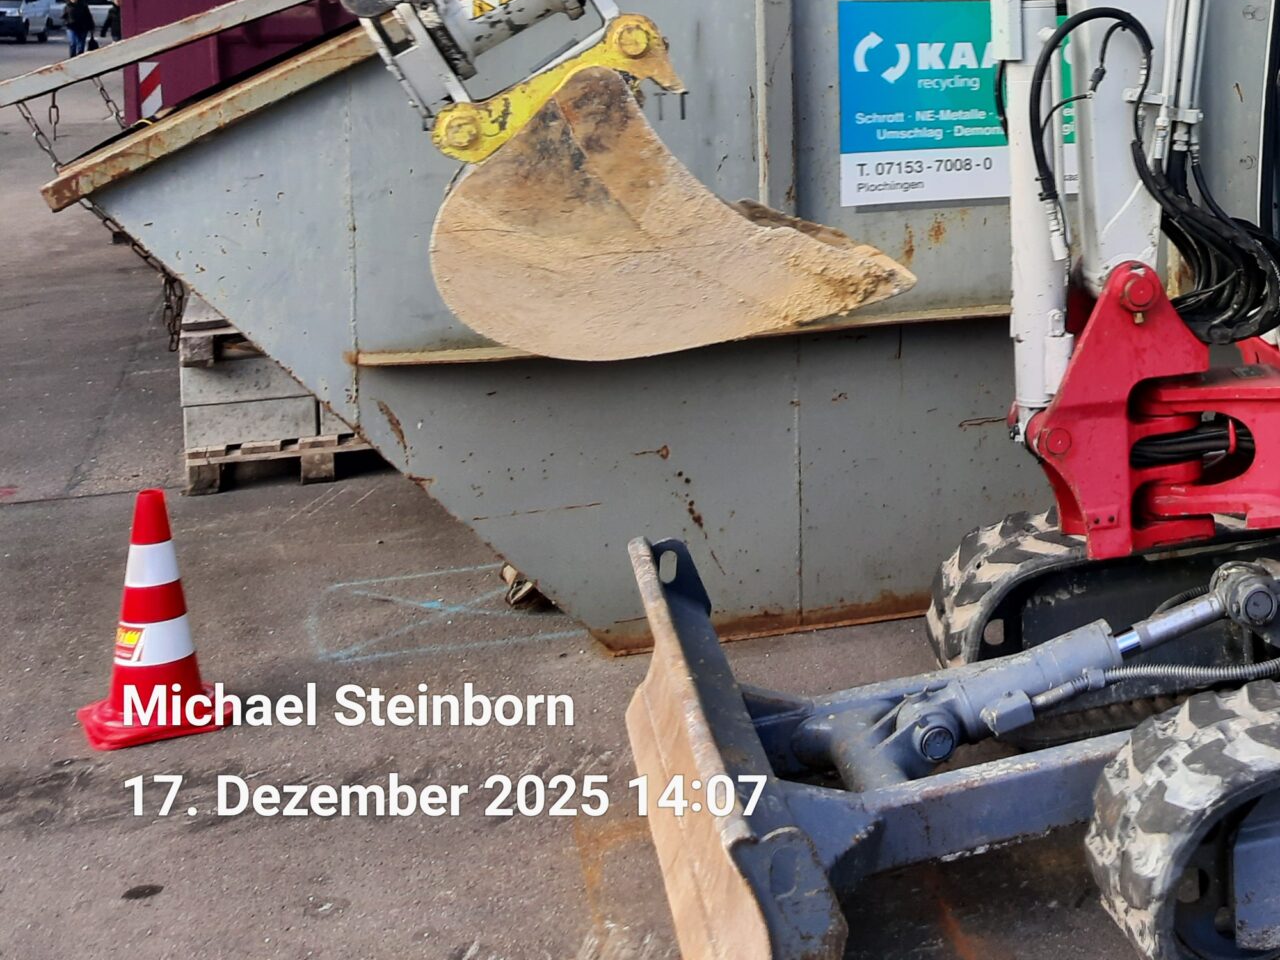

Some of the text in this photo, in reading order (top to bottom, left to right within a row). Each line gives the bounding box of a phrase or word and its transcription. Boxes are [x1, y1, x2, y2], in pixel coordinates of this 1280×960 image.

[917, 75, 980, 91] recycling
[855, 109, 986, 124] Schrott NE-Metalle
[876, 127, 943, 141] Umschlag
[857, 163, 870, 176] T.
[857, 179, 925, 192] Plochingen
